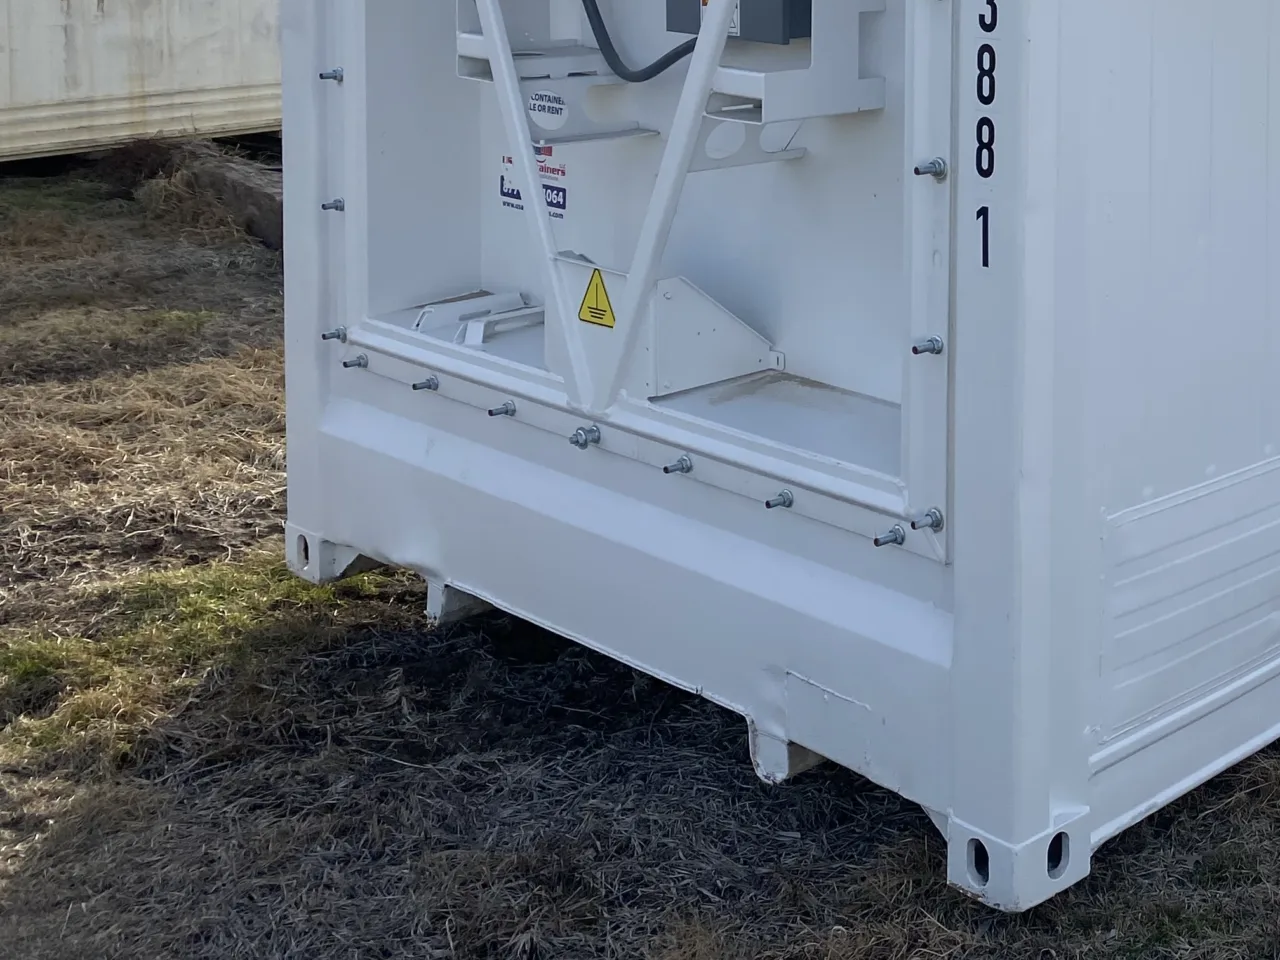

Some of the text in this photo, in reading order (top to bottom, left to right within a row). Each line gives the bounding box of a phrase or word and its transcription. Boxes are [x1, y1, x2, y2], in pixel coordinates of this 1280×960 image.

[537, 104, 547, 113] OR
[547, 105, 563, 116] RENT
[537, 164, 566, 177] ainers
